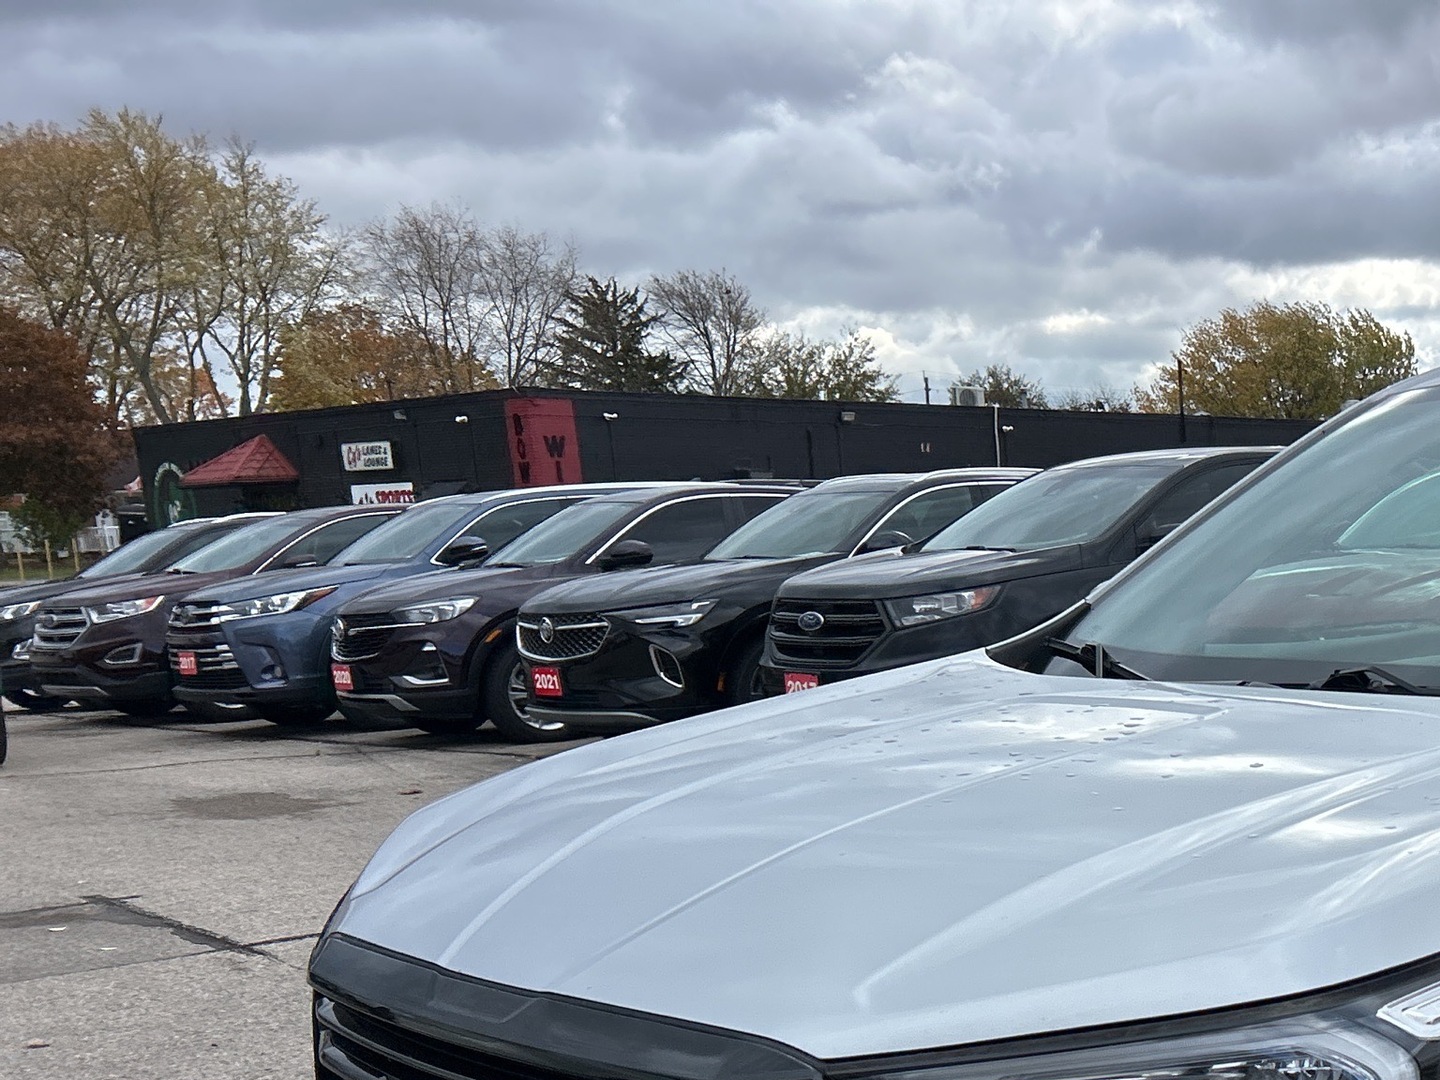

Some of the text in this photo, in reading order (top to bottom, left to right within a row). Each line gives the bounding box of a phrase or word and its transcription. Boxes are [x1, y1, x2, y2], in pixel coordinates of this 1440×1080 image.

[364, 457, 388, 467] LOUNGE
[179, 656, 195, 669] 2017
[333, 670, 351, 684] 2020
[535, 673, 559, 689] 2021
